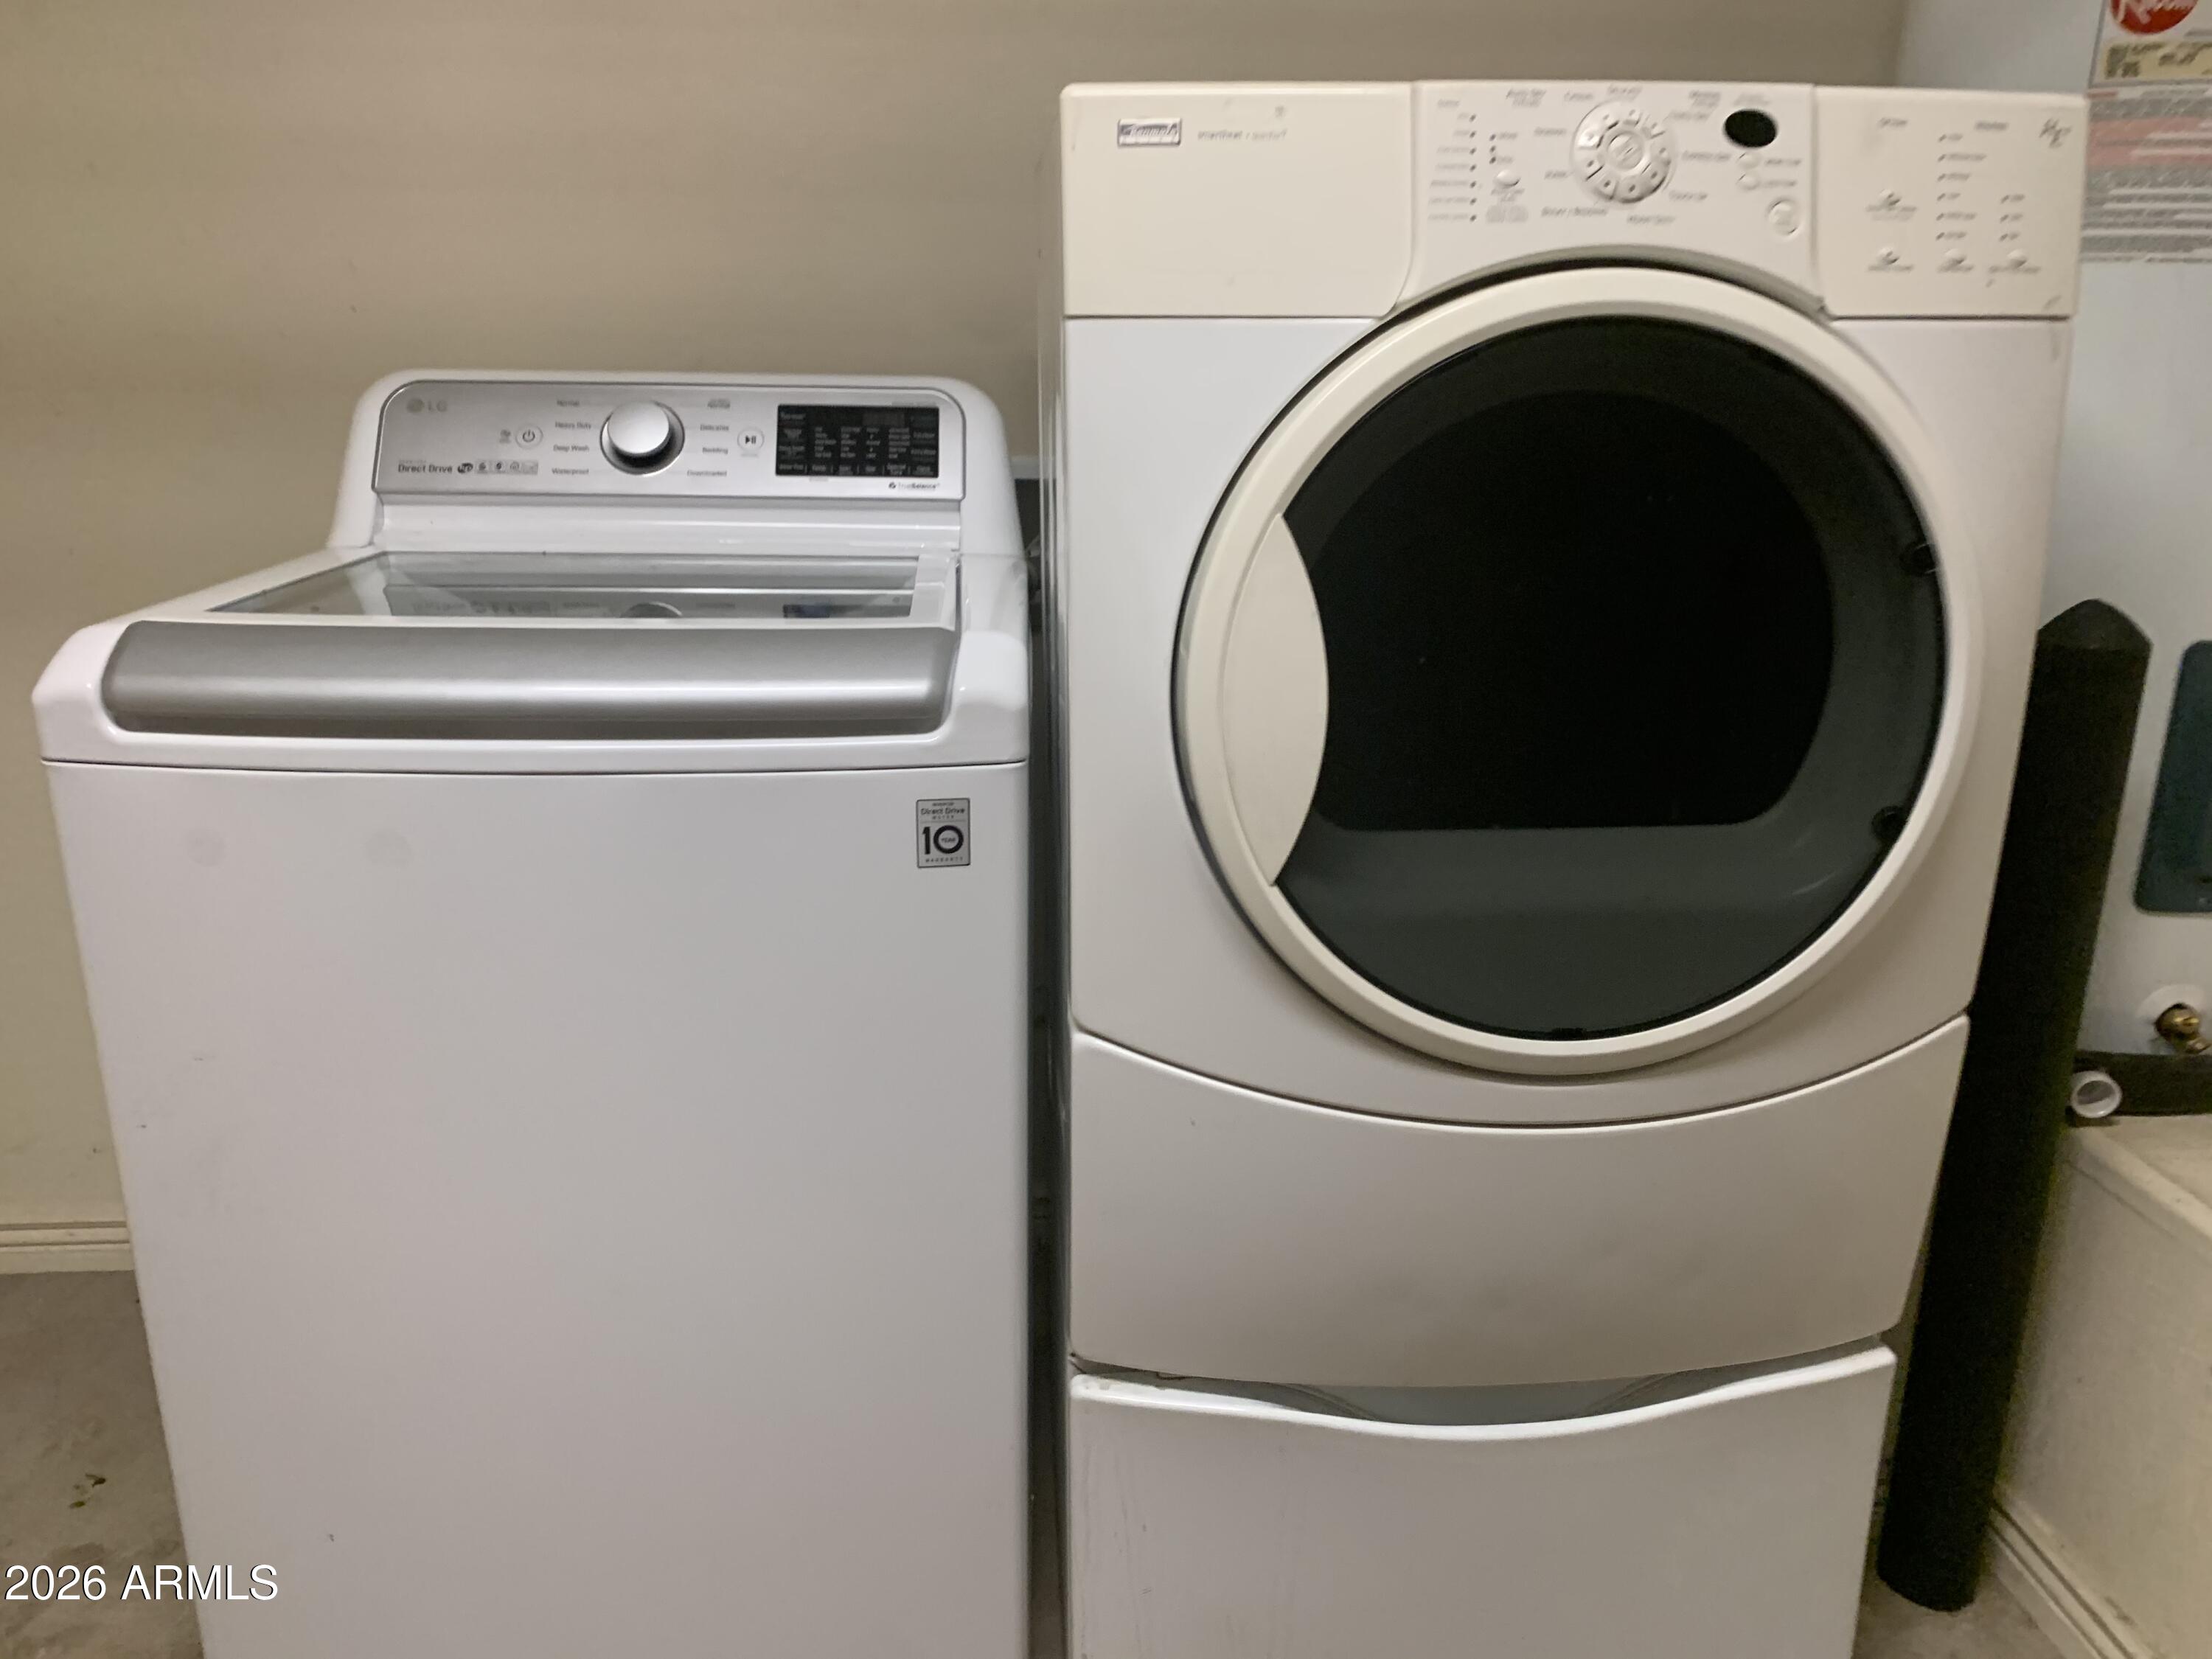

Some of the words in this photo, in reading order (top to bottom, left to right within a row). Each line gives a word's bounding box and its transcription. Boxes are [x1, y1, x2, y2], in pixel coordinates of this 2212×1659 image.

[428, 400, 448, 413] LG
[397, 463, 427, 473] Direct
[428, 463, 453, 473] Drive
[922, 824, 964, 855] 10
